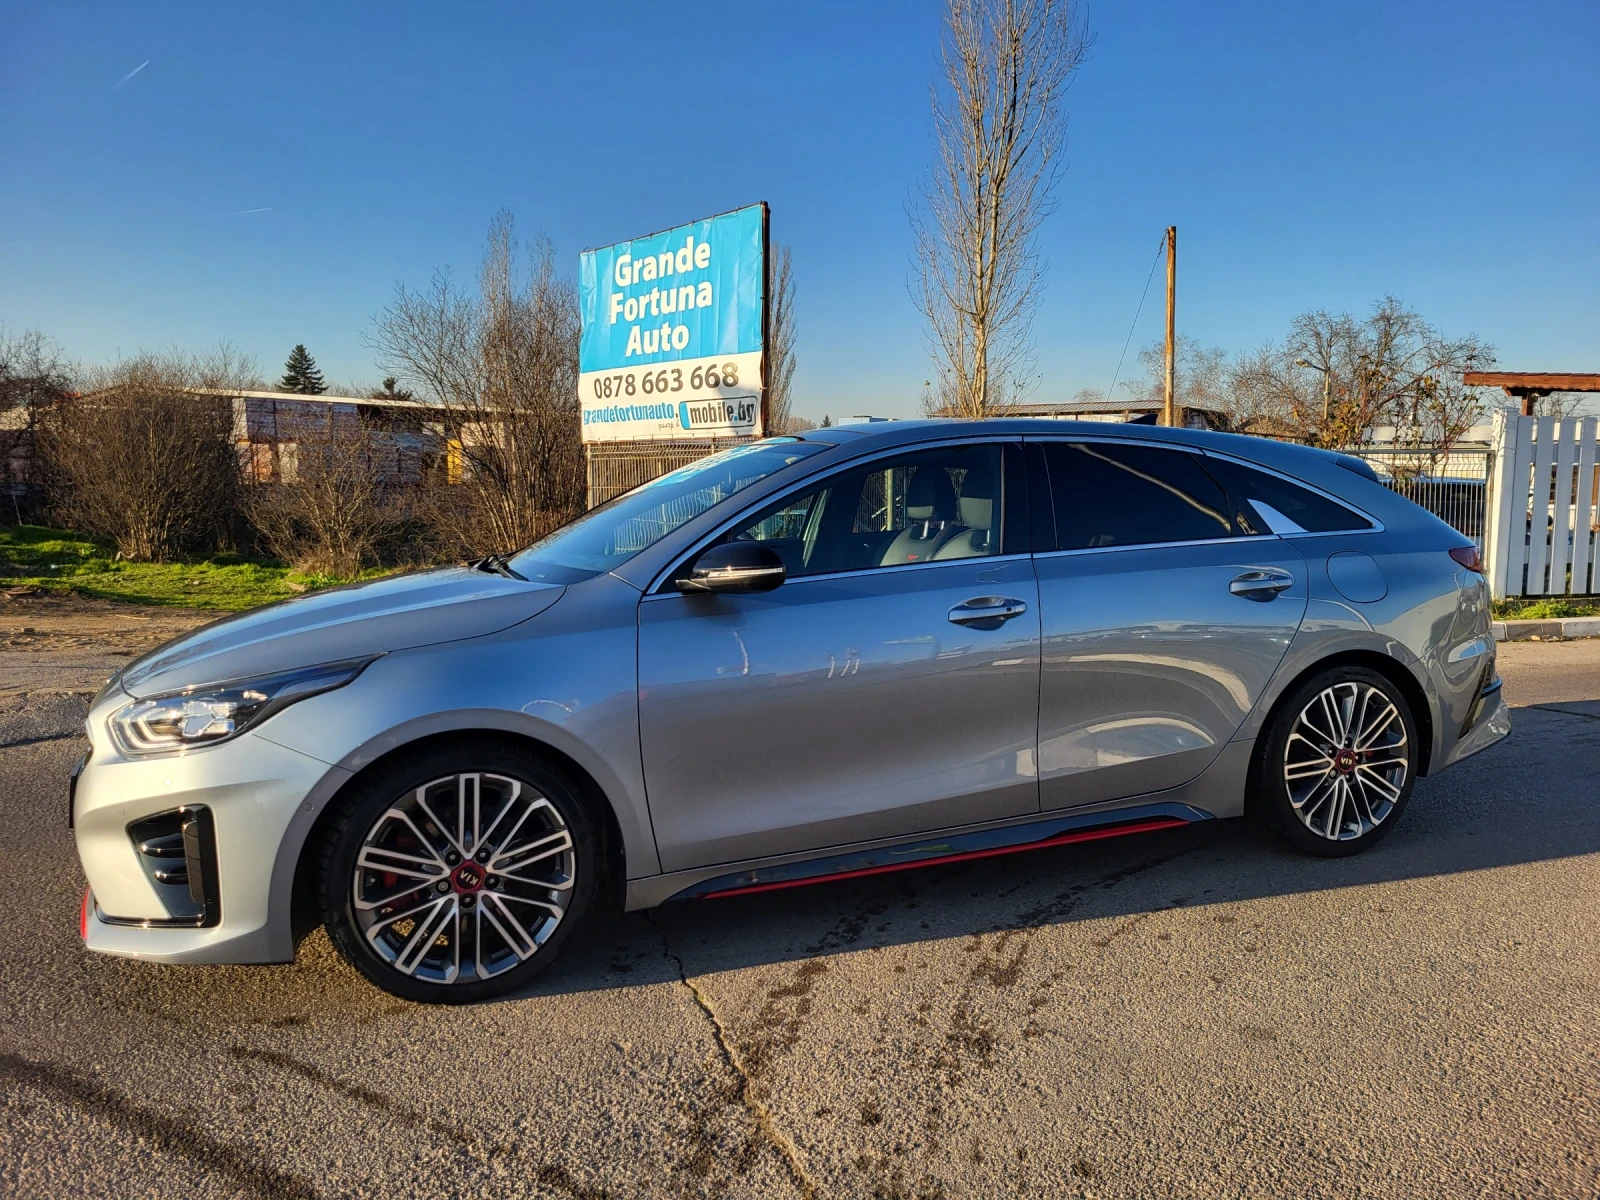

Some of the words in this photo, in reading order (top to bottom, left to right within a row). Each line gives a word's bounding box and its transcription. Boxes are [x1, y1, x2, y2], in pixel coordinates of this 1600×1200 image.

[614, 236, 711, 287] Grande
[610, 280, 712, 325] Fortuna
[625, 324, 689, 357] Auto
[594, 373, 636, 399] 0878
[641, 368, 683, 395] 663
[690, 362, 739, 390] 668
[689, 398, 755, 424] mobile.bg
[460, 869, 479, 886] KIA
